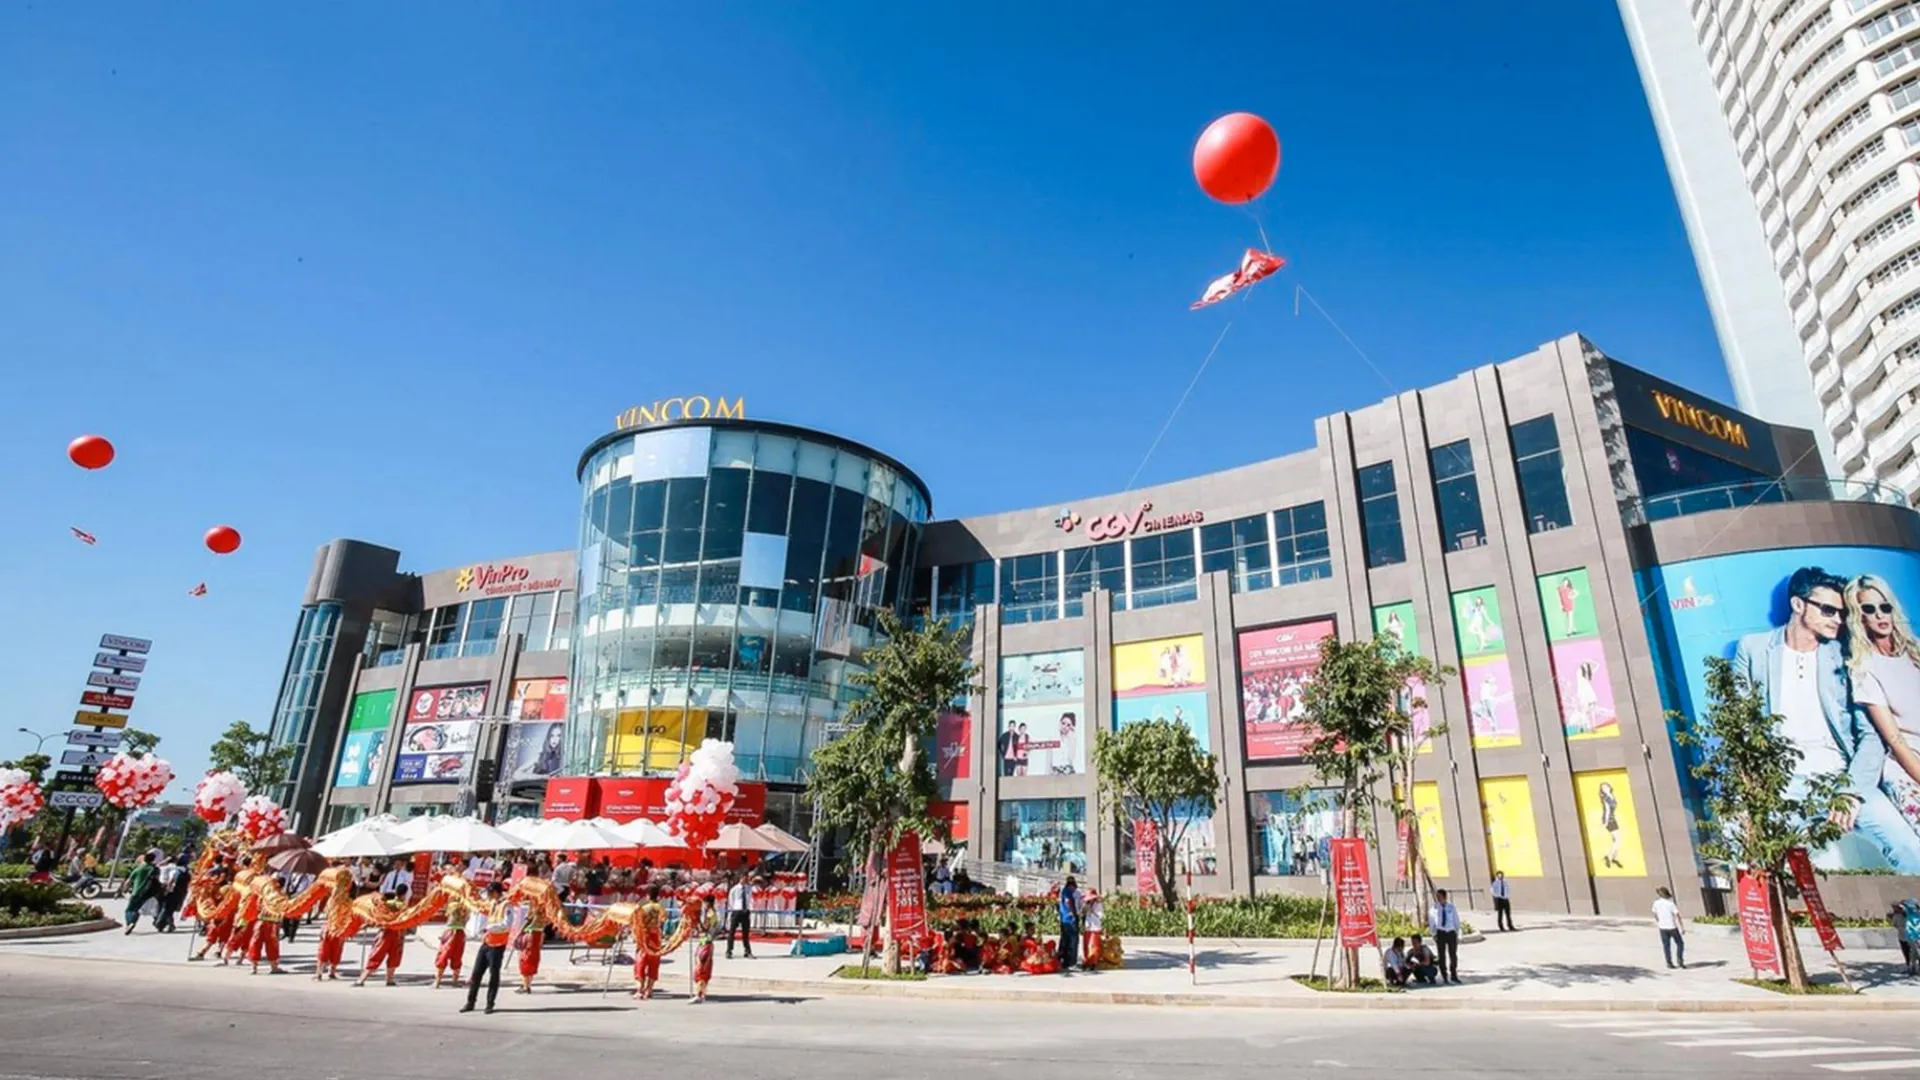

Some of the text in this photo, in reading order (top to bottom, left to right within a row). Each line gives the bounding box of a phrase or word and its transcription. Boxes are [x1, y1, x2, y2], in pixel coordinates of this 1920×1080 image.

[615, 395, 745, 430] VINCOM
[1651, 389, 1749, 449] VINCOM
[1085, 501, 1204, 541] CGV CINEMAS
[475, 565, 529, 590] VinPro
[108, 638, 147, 648] VINCOM
[54, 794, 99, 805] ecco
